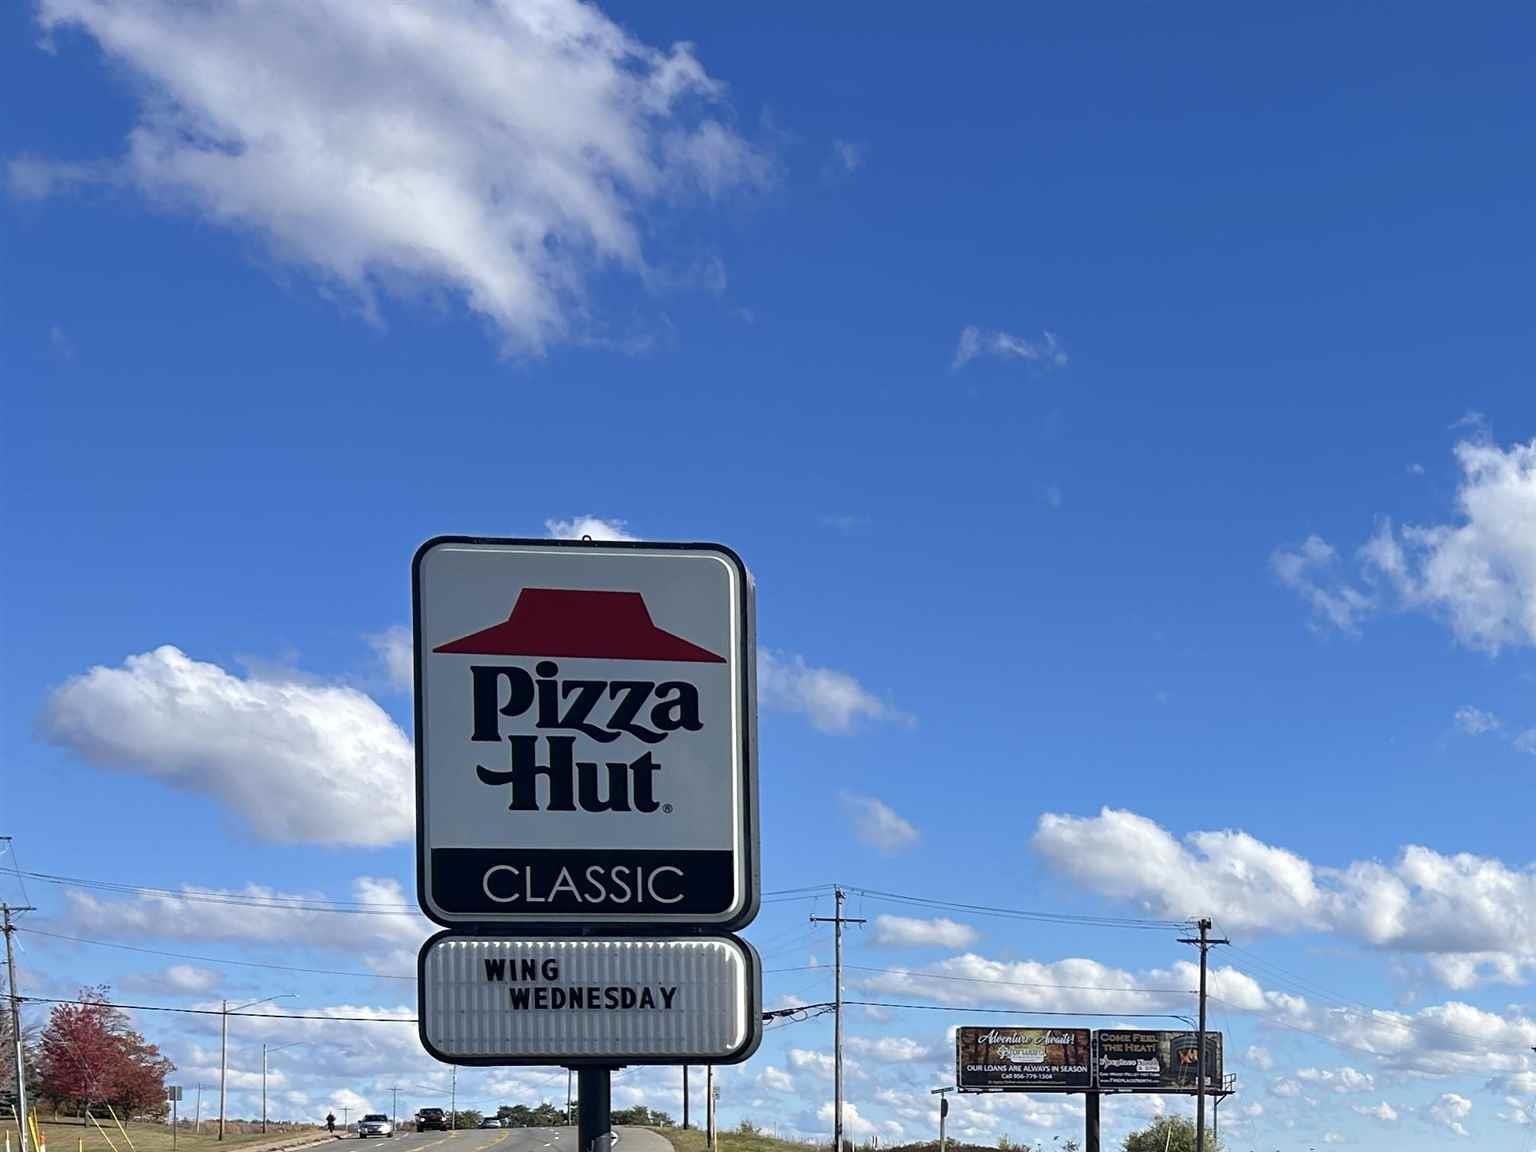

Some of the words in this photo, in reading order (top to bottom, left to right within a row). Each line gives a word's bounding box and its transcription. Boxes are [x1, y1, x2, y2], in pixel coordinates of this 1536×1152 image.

[470, 661, 703, 743] Pizza
[476, 735, 661, 812] Hut
[483, 865, 685, 904] CLASSIC
[485, 959, 560, 981] WING
[509, 987, 677, 1010] WEDNESDAY
